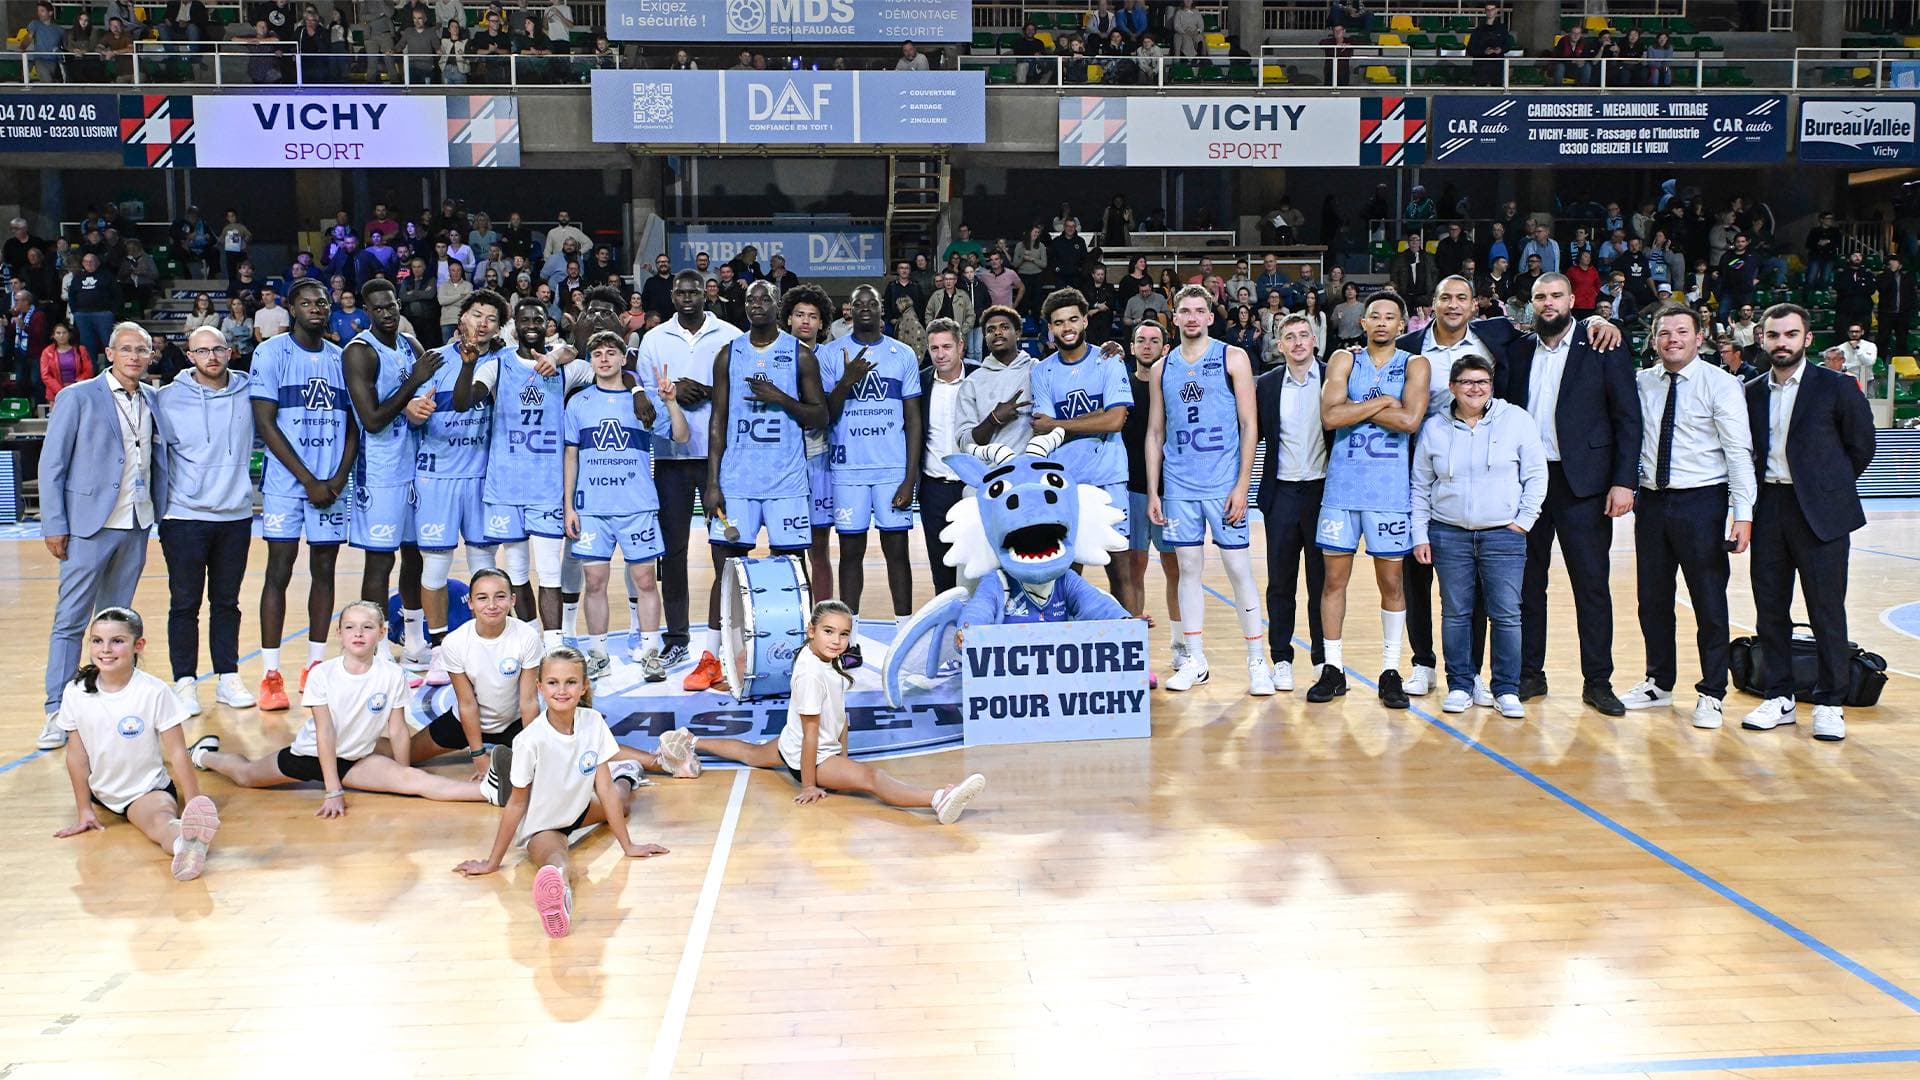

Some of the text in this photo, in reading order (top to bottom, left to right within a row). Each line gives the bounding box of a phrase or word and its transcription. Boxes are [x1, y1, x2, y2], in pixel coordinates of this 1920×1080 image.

[640, 0, 687, 15] Exigez
[770, 0, 855, 23] MDS
[885, 8, 958, 20] DÉMONTAGE
[621, 13, 634, 26] la
[638, 13, 697, 27] sécurité
[770, 24, 856, 35] ÉCHAFAUDAGE
[885, 25, 945, 37] SÉCURITÉ
[748, 78, 832, 121] DAF
[17, 104, 36, 121] 70
[38, 104, 56, 121] 42
[58, 104, 76, 121] 40
[78, 104, 97, 121] 46
[252, 103, 388, 130] VICHY
[1181, 104, 1306, 131] VICHY
[1527, 103, 1593, 117] CARROSSERIE
[1602, 103, 1660, 118] MECANIQUE
[1668, 103, 1709, 117] VITRAGE
[7, 126, 41, 138] TUREAU
[50, 126, 79, 138] 03230
[81, 126, 118, 138] LUSIGNY
[1448, 119, 1510, 134] CAR auto
[1713, 118, 1774, 132] CAR auto
[1528, 128, 1537, 140] ZI
[1596, 128, 1637, 141] Passage
[1639, 127, 1651, 139] de
[284, 143, 364, 160] SPORT
[1208, 142, 1282, 160] SPORT
[1559, 142, 1669, 155] 03300 CREUZIER LE VIEUX
[1872, 145, 1899, 159] Vichy
[520, 409, 544, 426] 77
[1187, 406, 1200, 424] 2
[849, 427, 887, 437] VICHY
[417, 453, 436, 472] 21
[590, 458, 638, 466] INTERSPORT
[588, 477, 627, 486] VICHY
[319, 512, 344, 527] PCE
[783, 516, 809, 531] PCE
[1378, 521, 1405, 537] PCE
[965, 641, 1145, 679] VICTOIRE
[968, 690, 1145, 721] POUR VICHY
